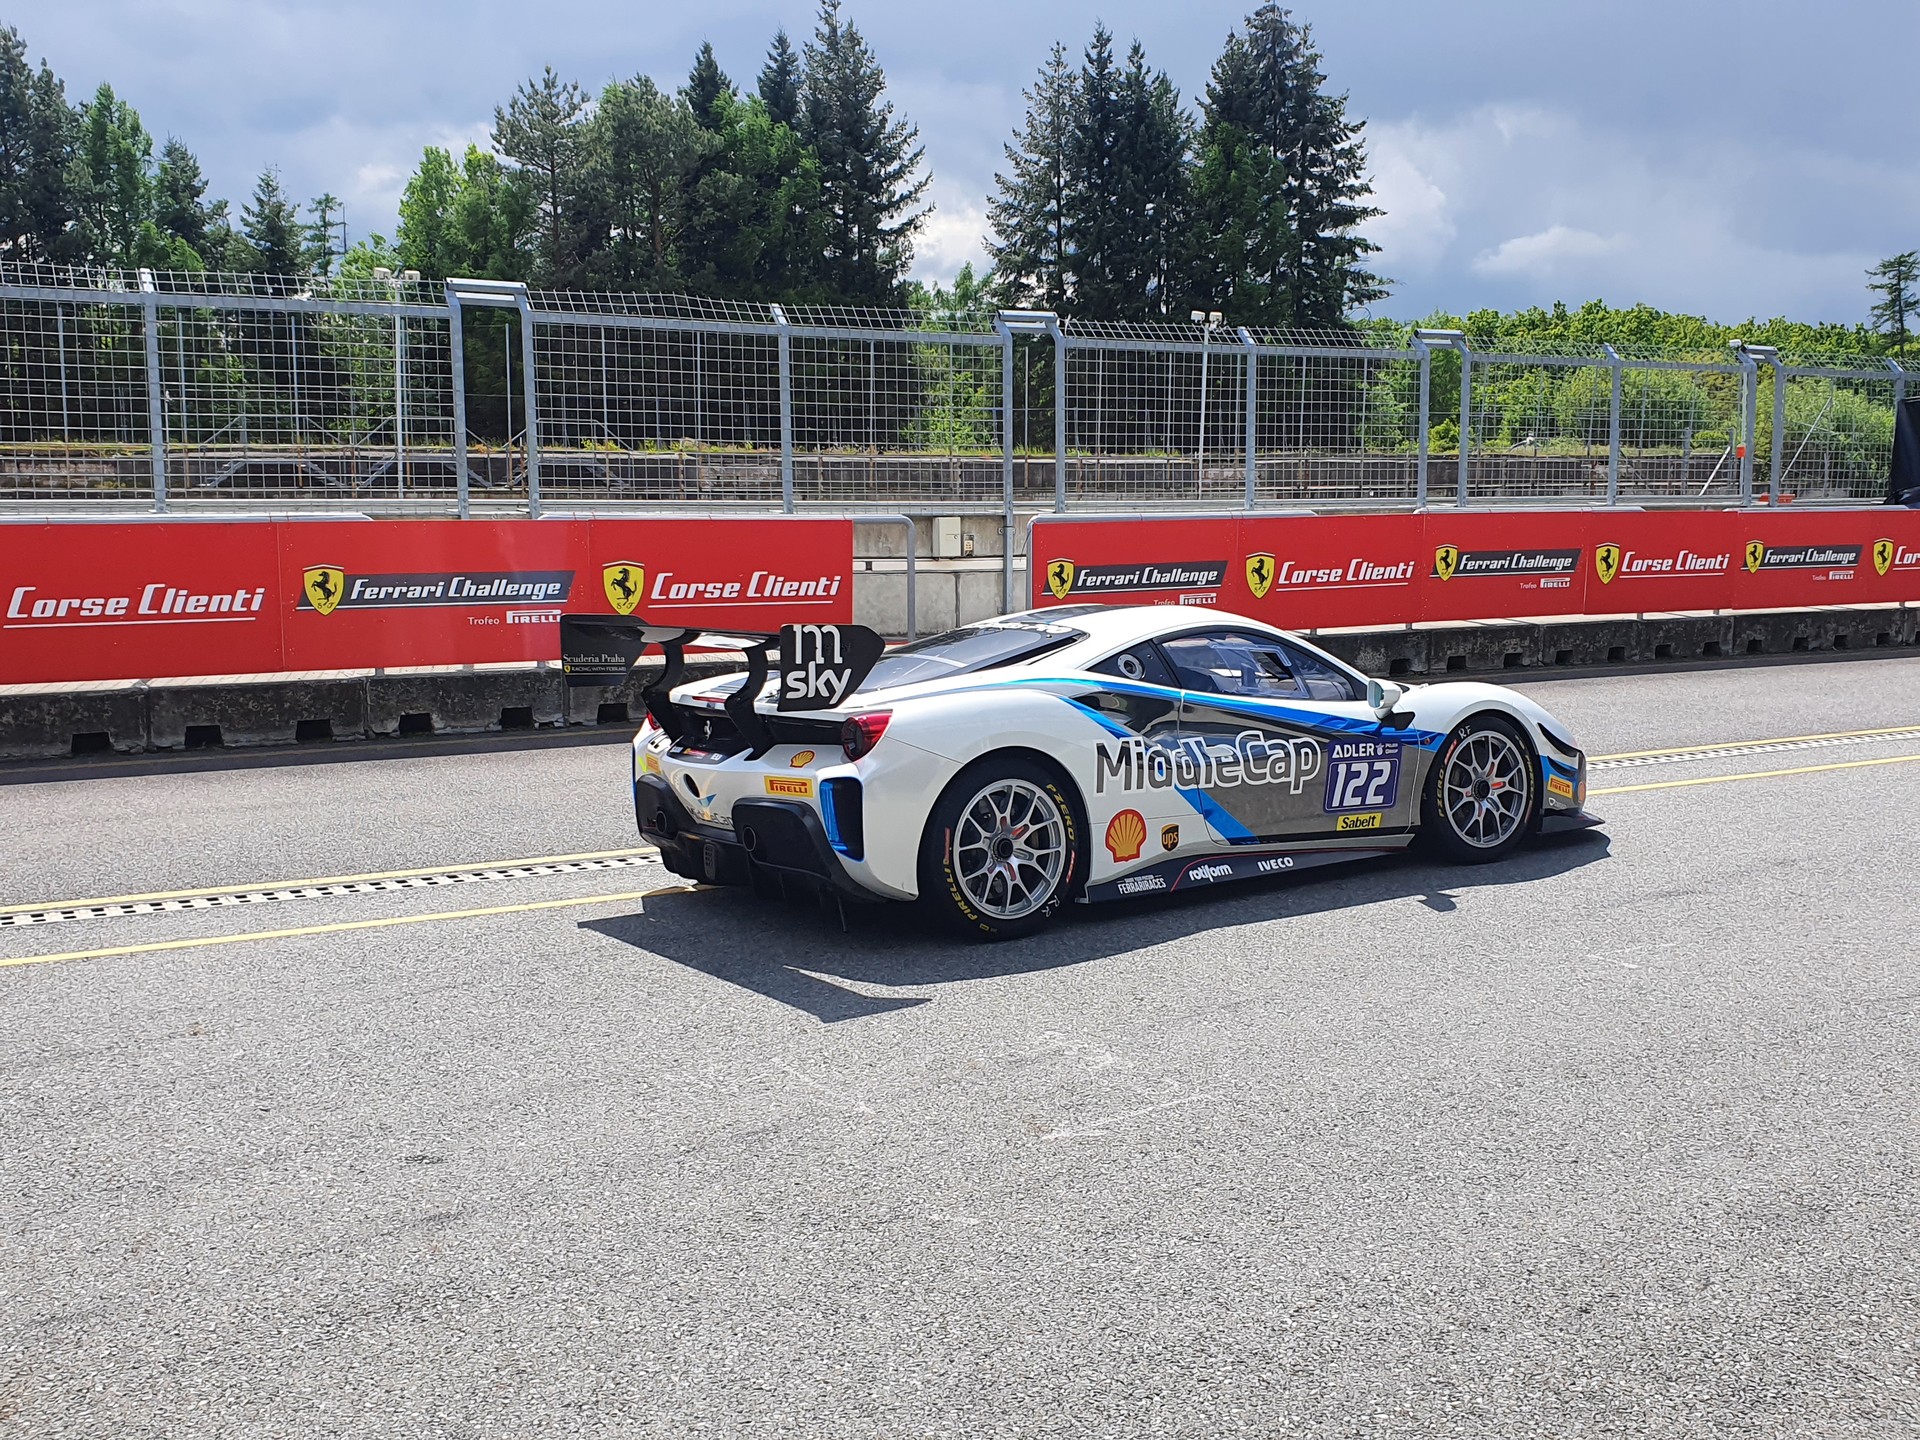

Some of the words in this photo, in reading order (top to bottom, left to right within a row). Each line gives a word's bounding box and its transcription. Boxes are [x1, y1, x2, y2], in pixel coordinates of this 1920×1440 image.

[1460, 555, 1510, 571] Ferrari
[1510, 552, 1572, 571] Challenge
[1621, 552, 1673, 572] Corse
[1675, 550, 1730, 571] Clienti
[1764, 549, 1807, 563] Ferrari
[1806, 549, 1856, 564] Challenge
[1077, 569, 1140, 588] Ferrari
[1141, 566, 1218, 586] Challenge
[1278, 561, 1342, 584] Corse
[1346, 558, 1415, 581] Clienti
[1829, 570, 1855, 580] PIRELLI
[350, 578, 445, 600] Ferrari
[447, 577, 561, 601] Challenge
[651, 572, 740, 600] Corse
[746, 571, 841, 598] Clienti
[1540, 577, 1571, 588] PIRELLI
[6, 586, 130, 619] Corse
[138, 583, 265, 615] Clienti
[1179, 592, 1217, 605] PIRELLI
[468, 616, 500, 625] Trofeo
[506, 609, 562, 624] PIRELLI
[563, 653, 600, 663] Scuderia
[601, 653, 625, 663] Praha
[785, 660, 853, 705] sky
[1332, 743, 1375, 759] ADLER
[1095, 730, 1322, 796] MiddleCap
[770, 779, 807, 794] PIRELLI
[1331, 761, 1391, 808] 122
[1550, 777, 1571, 795] PIRELLI
[1341, 815, 1376, 830] Sabelt
[1162, 832, 1179, 848] ups
[1188, 864, 1233, 882] rotiform
[1257, 857, 1294, 872] IVECO
[944, 867, 978, 921] PIRELLI
